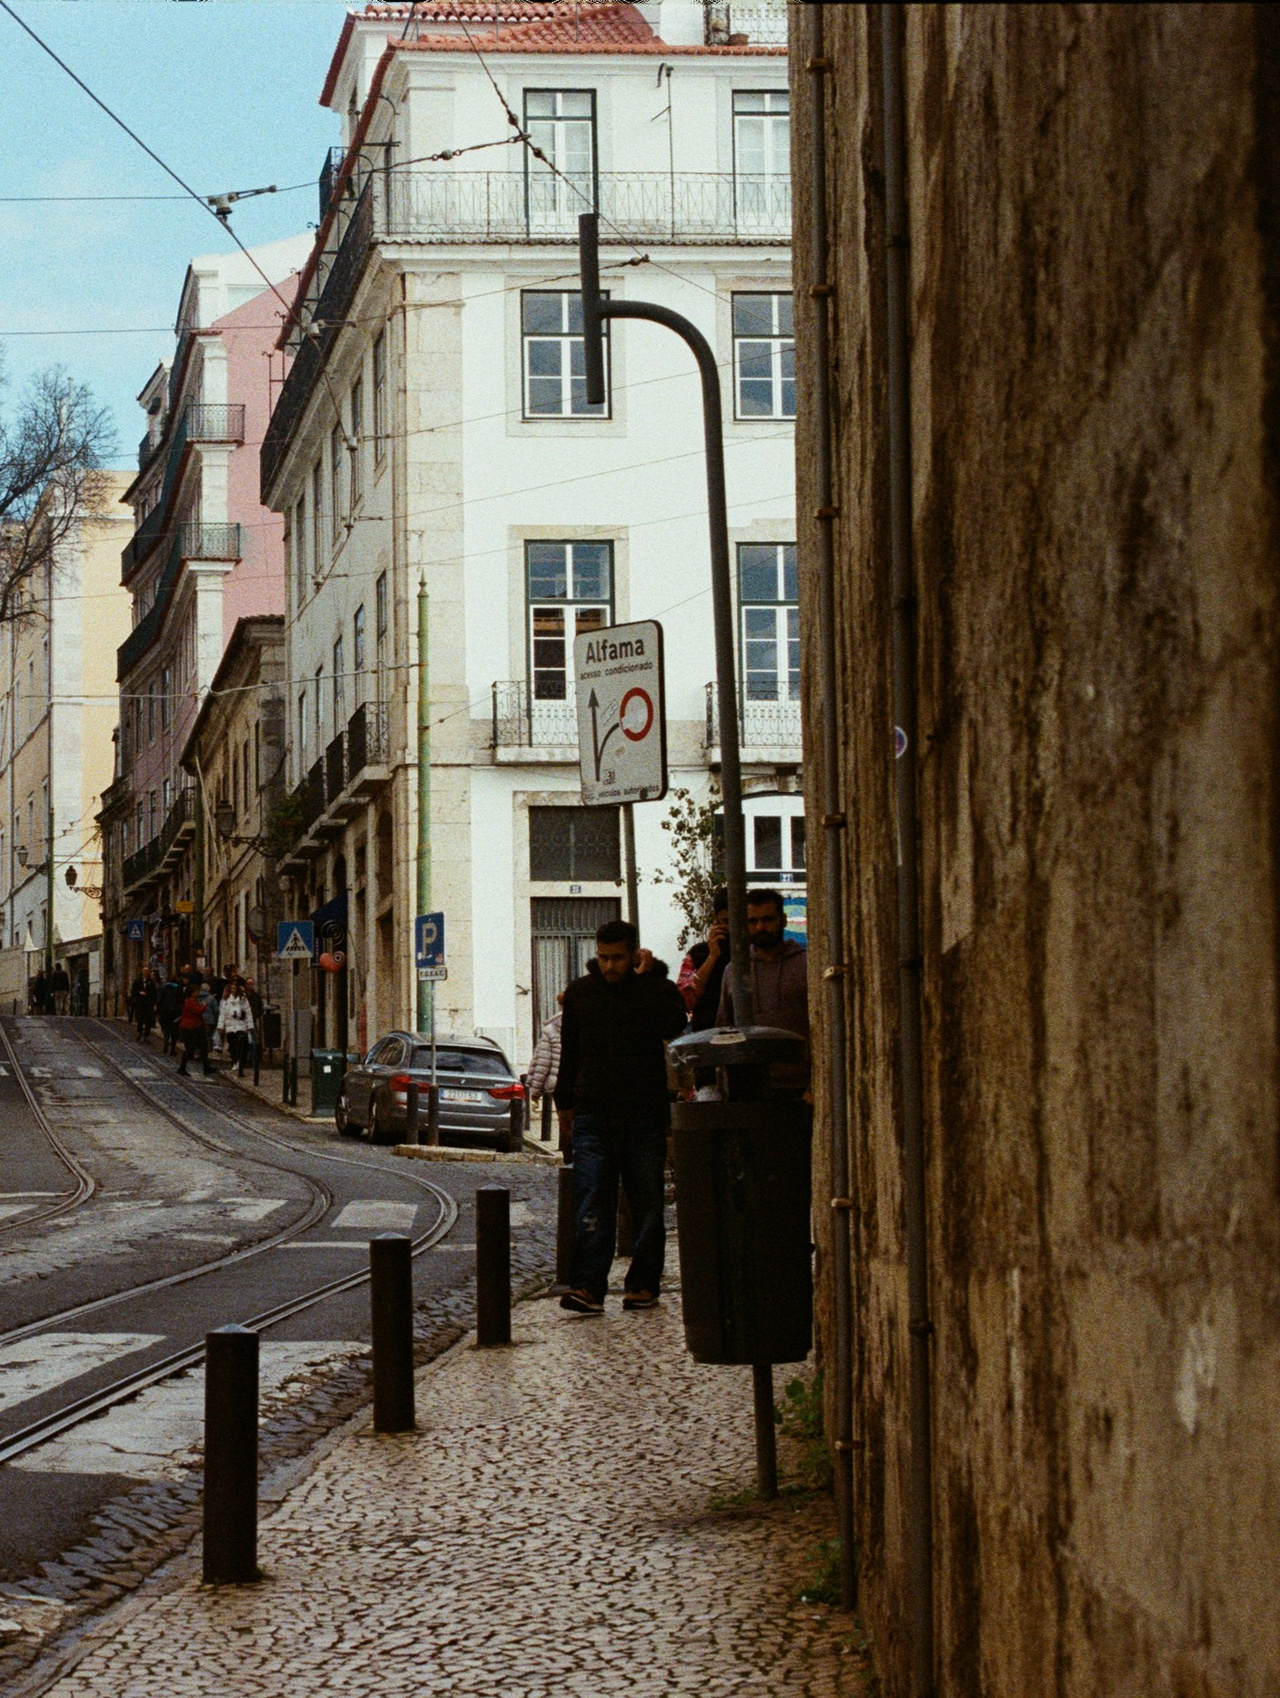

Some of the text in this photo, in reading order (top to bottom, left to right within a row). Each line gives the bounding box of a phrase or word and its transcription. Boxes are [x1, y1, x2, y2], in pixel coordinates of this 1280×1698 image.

[586, 638, 645, 664] Alfama
[580, 661, 653, 680] acesso condicionado
[422, 922, 438, 960] P
